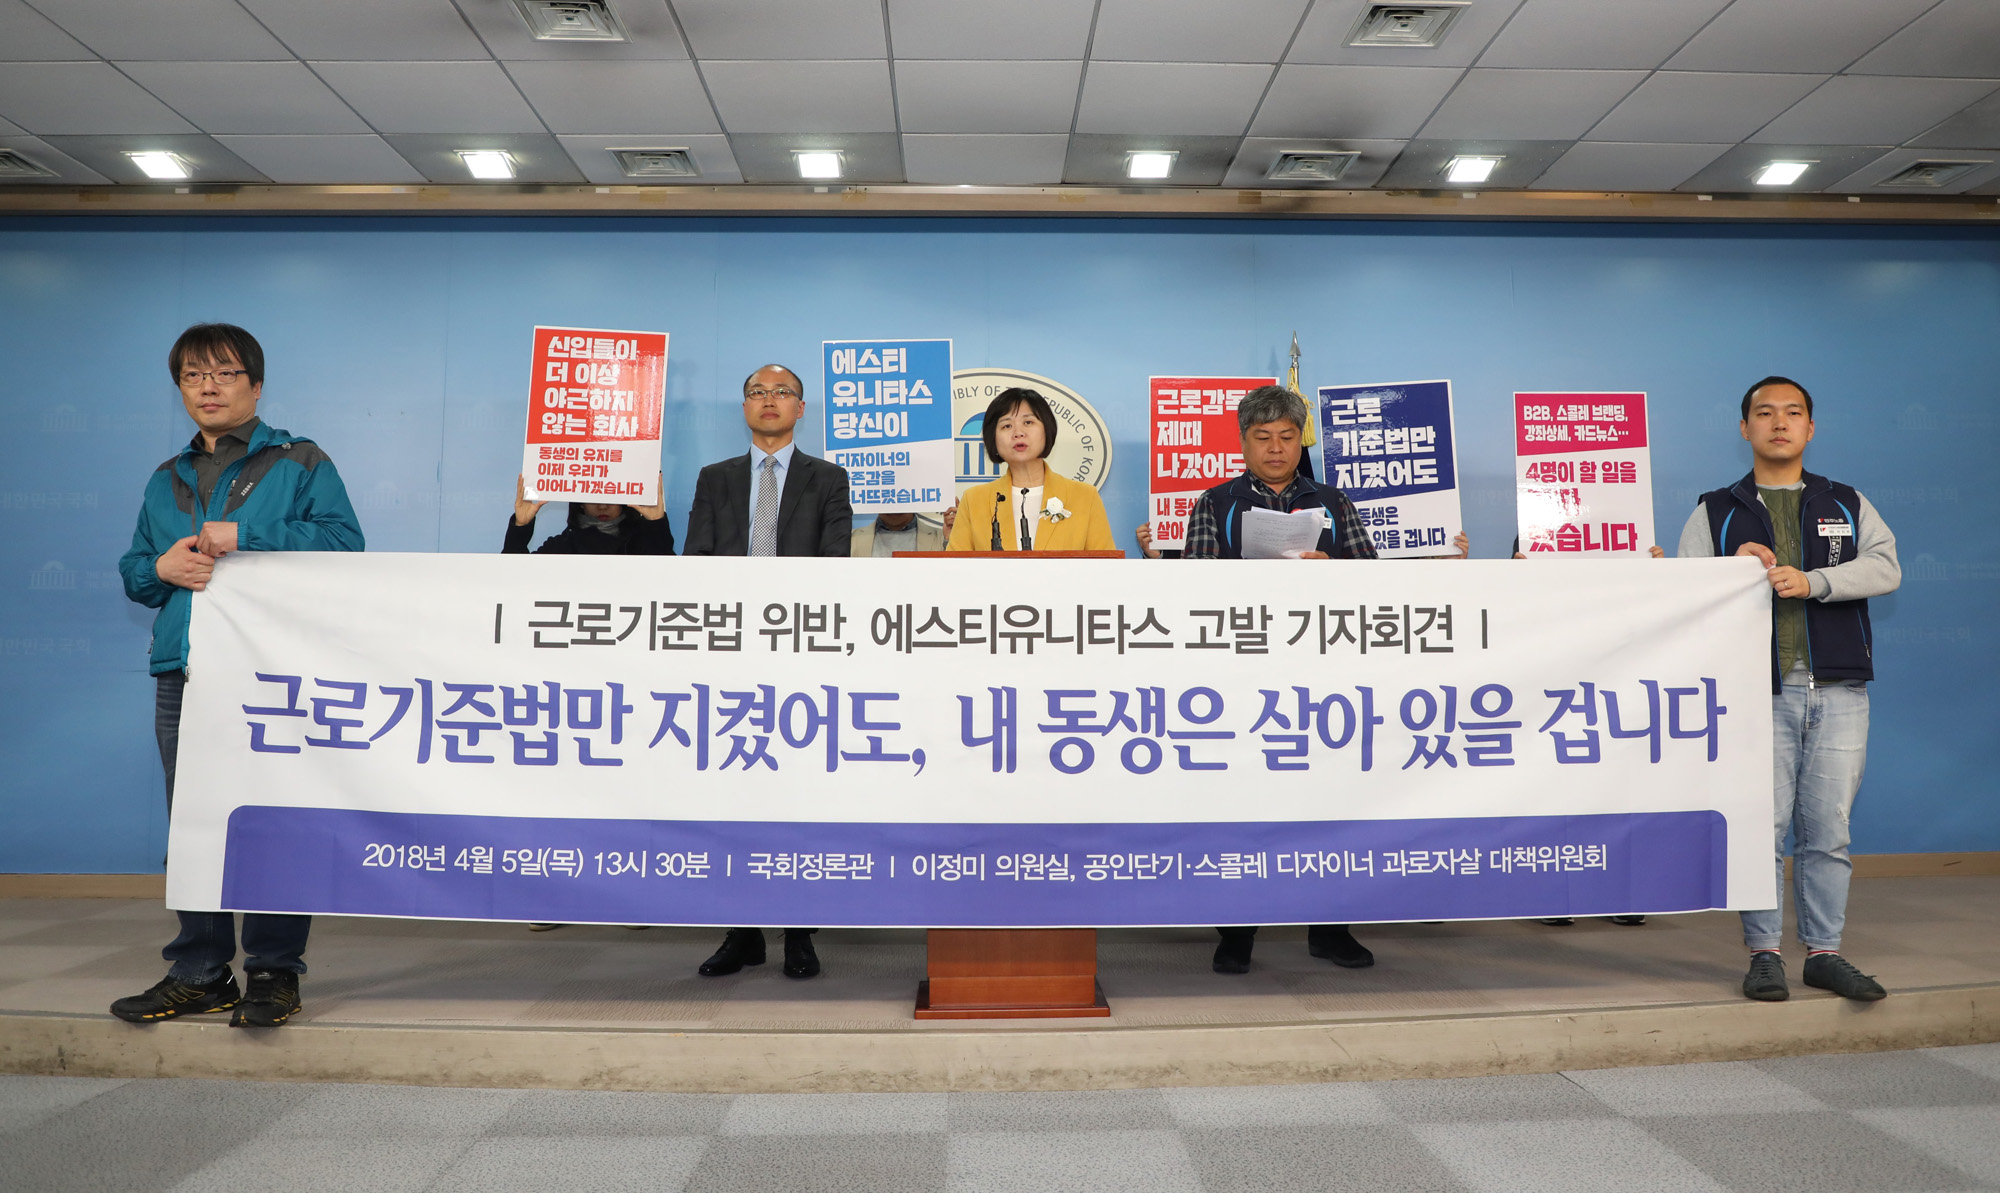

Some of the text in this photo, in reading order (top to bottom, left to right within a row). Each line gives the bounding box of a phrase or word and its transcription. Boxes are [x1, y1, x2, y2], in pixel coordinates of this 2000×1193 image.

[547, 336, 638, 361] 신입들이
[831, 347, 907, 375] 에스티
[545, 361, 620, 386] 더 이상
[543, 387, 635, 412] 야근하지
[832, 379, 933, 407] 유니타스
[953, 385, 1001, 400] BLY OF
[1156, 389, 1252, 415] 근로감독
[1331, 397, 1383, 426] 근로
[1523, 404, 1629, 422] B2B, 스콜레 브랜딩,
[541, 412, 639, 438] 않는 회사
[832, 411, 909, 440] 당신이
[1156, 420, 1202, 447] 제때
[1524, 424, 1572, 442] 강좌상세,
[1043, 396, 1095, 482] PUBLIC OF KOR
[1332, 425, 1437, 457] 기준법만
[539, 446, 623, 463] 동생의 유지를
[835, 451, 910, 468] 디자이너의
[1156, 452, 1247, 479] 나갔어도
[537, 462, 609, 478] 이제 우리가
[847, 470, 896, 486] 존감을
[1334, 458, 1439, 490] 지켰어도
[1525, 460, 1637, 484] 4명이 할 일을
[536, 478, 644, 496] 이어나가겠습니다
[848, 487, 942, 505] 너뜨렸습니다
[1157, 497, 1170, 517] 내
[1157, 521, 1184, 541] 살아
[1372, 527, 1447, 550] 있을 겁니다
[528, 600, 1454, 657] 근로기준법 위반, 에스티유니타스 고발 기자회견
[241, 671, 1728, 778] 근로기준법만 지켰어도, 내 동생은 살아 있을 겁니다
[362, 842, 1608, 883] 2018년 4월 5일(목) 13시 30분 국회정론관 이정미 의원실, 공인단기·스콜레 디자이너 과로자살 대책위원회
